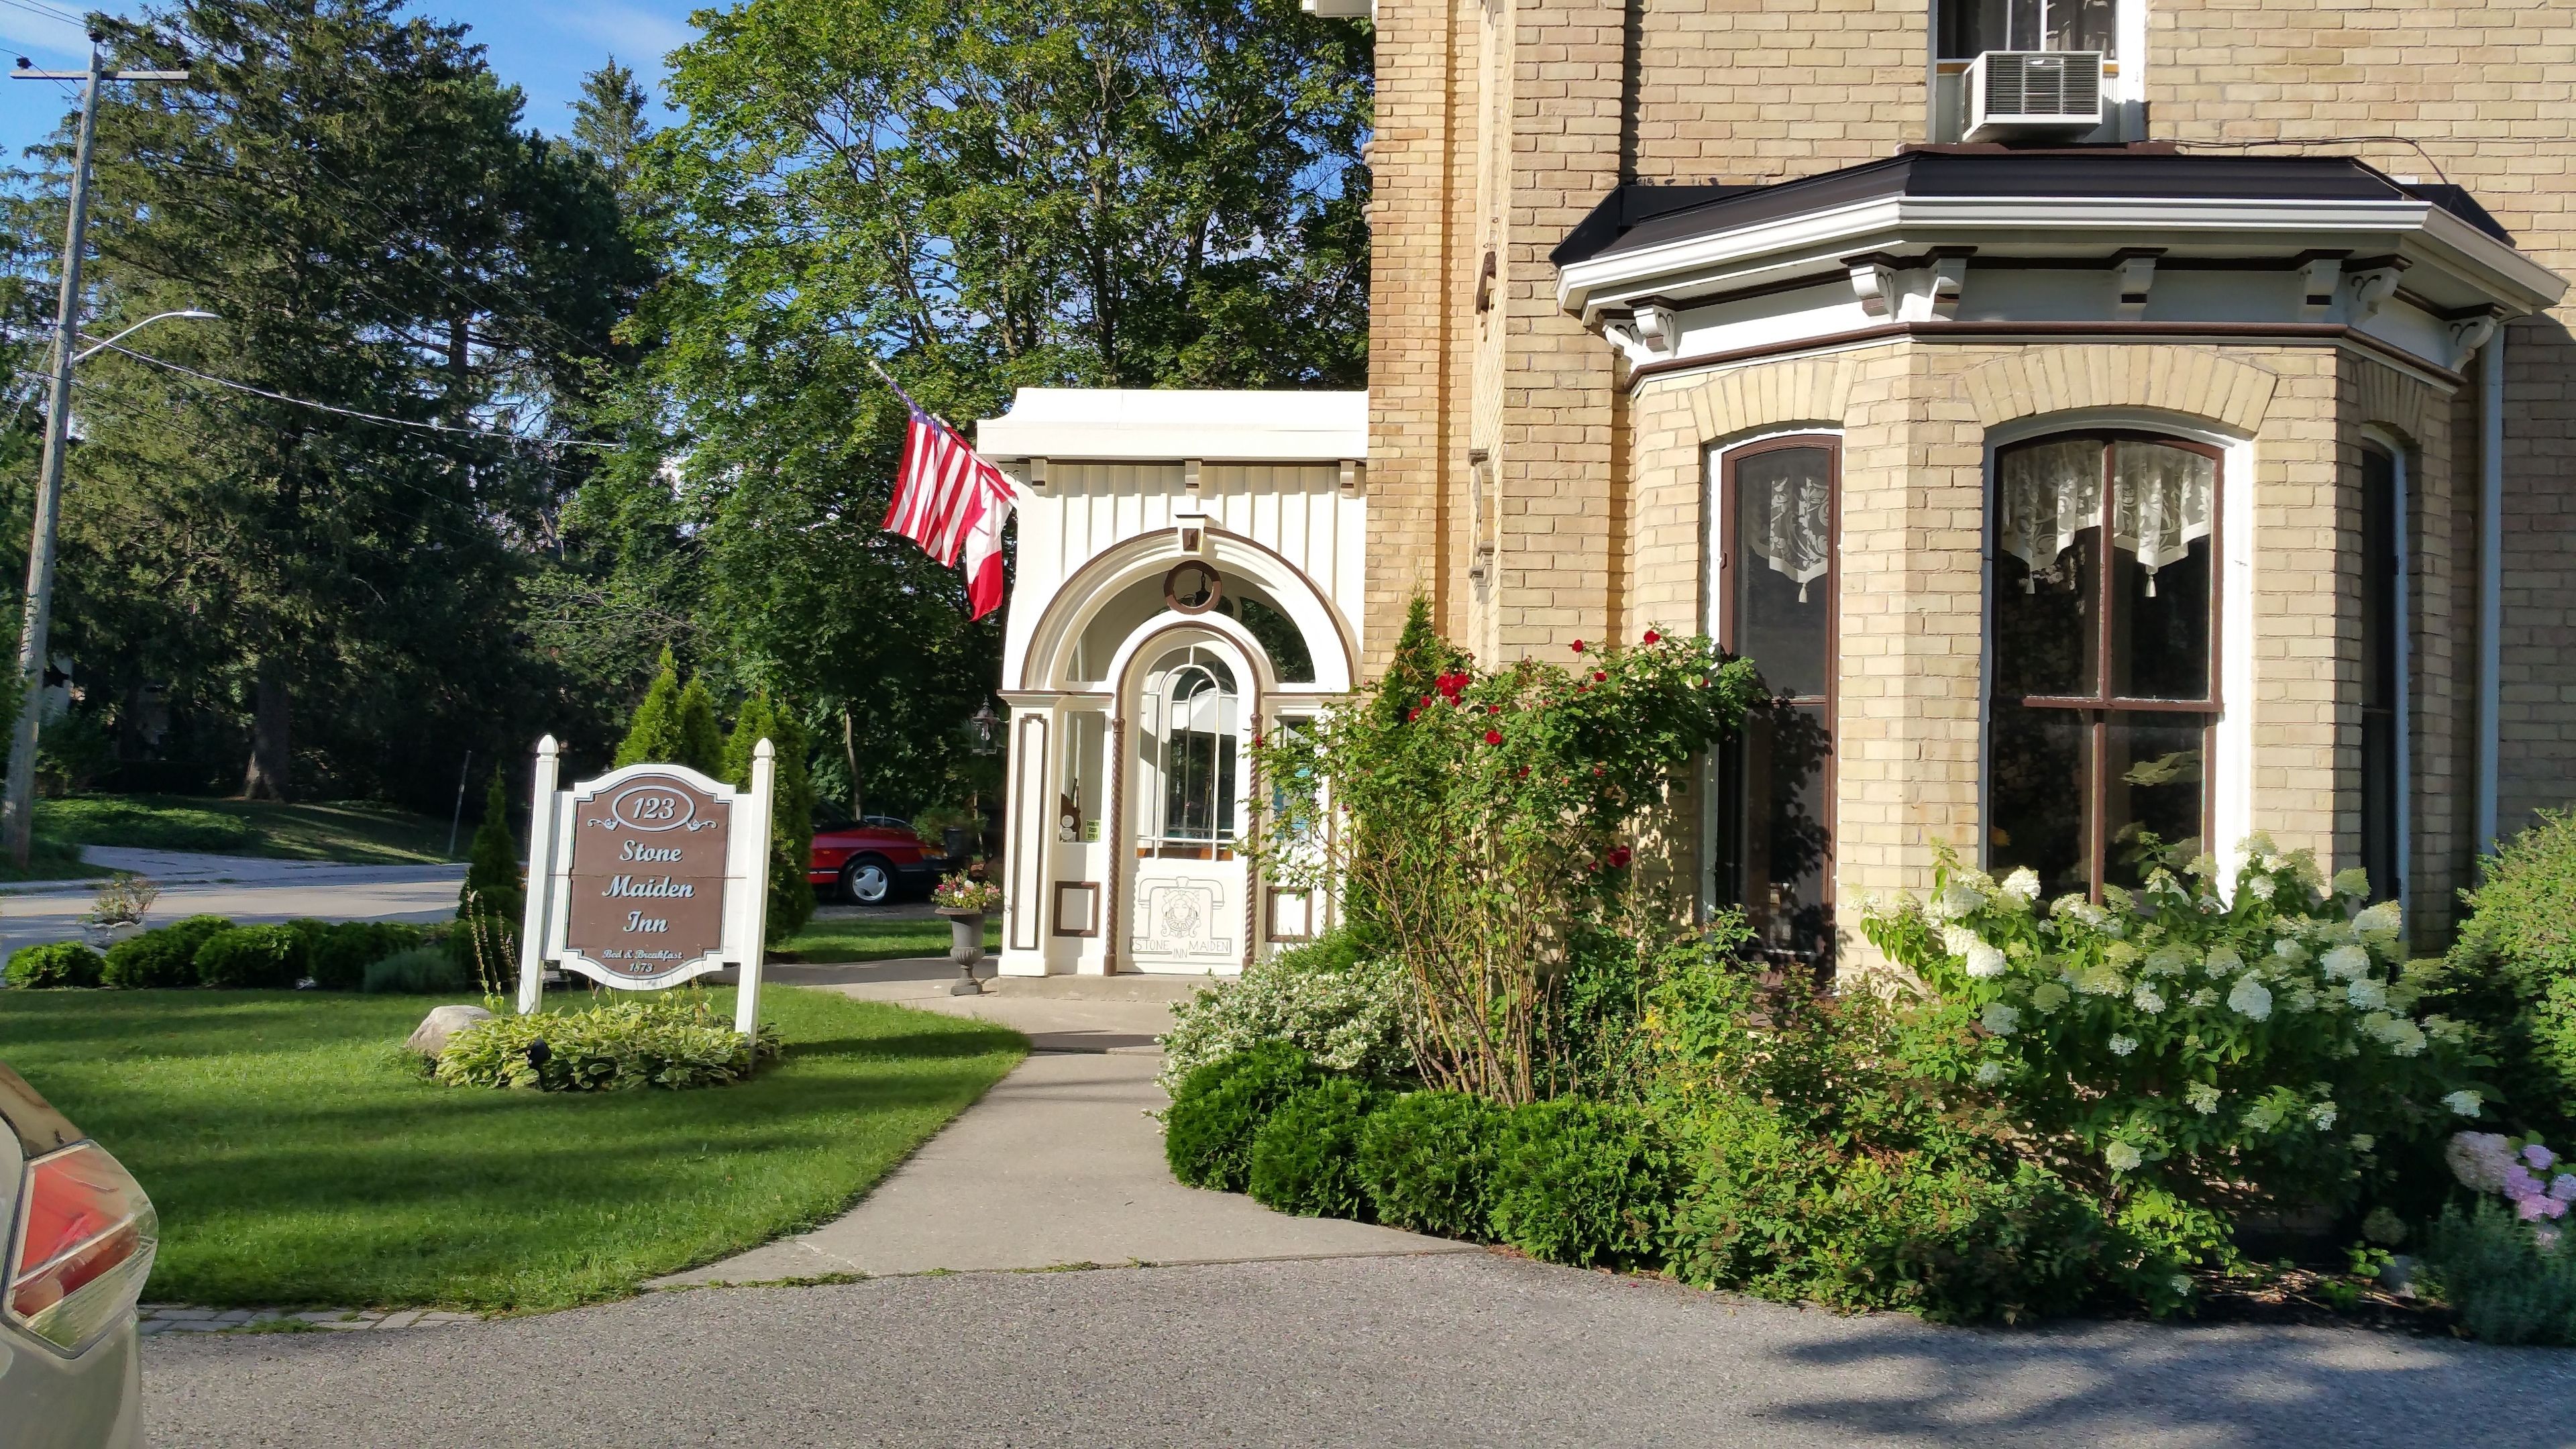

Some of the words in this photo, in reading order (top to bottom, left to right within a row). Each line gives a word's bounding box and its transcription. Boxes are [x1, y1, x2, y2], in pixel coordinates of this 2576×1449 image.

[633, 797, 676, 820] 123
[619, 839, 683, 862] Stone
[602, 875, 695, 898] Maiden
[623, 910, 669, 932] Inn
[1135, 939, 1170, 951] STONE
[1189, 941, 1229, 951] MAIDEN
[1173, 948, 1188, 959] INN
[602, 949, 623, 959] Bed
[624, 949, 633, 959] &
[635, 949, 683, 961] Breakfast
[629, 963, 654, 972] 1873
